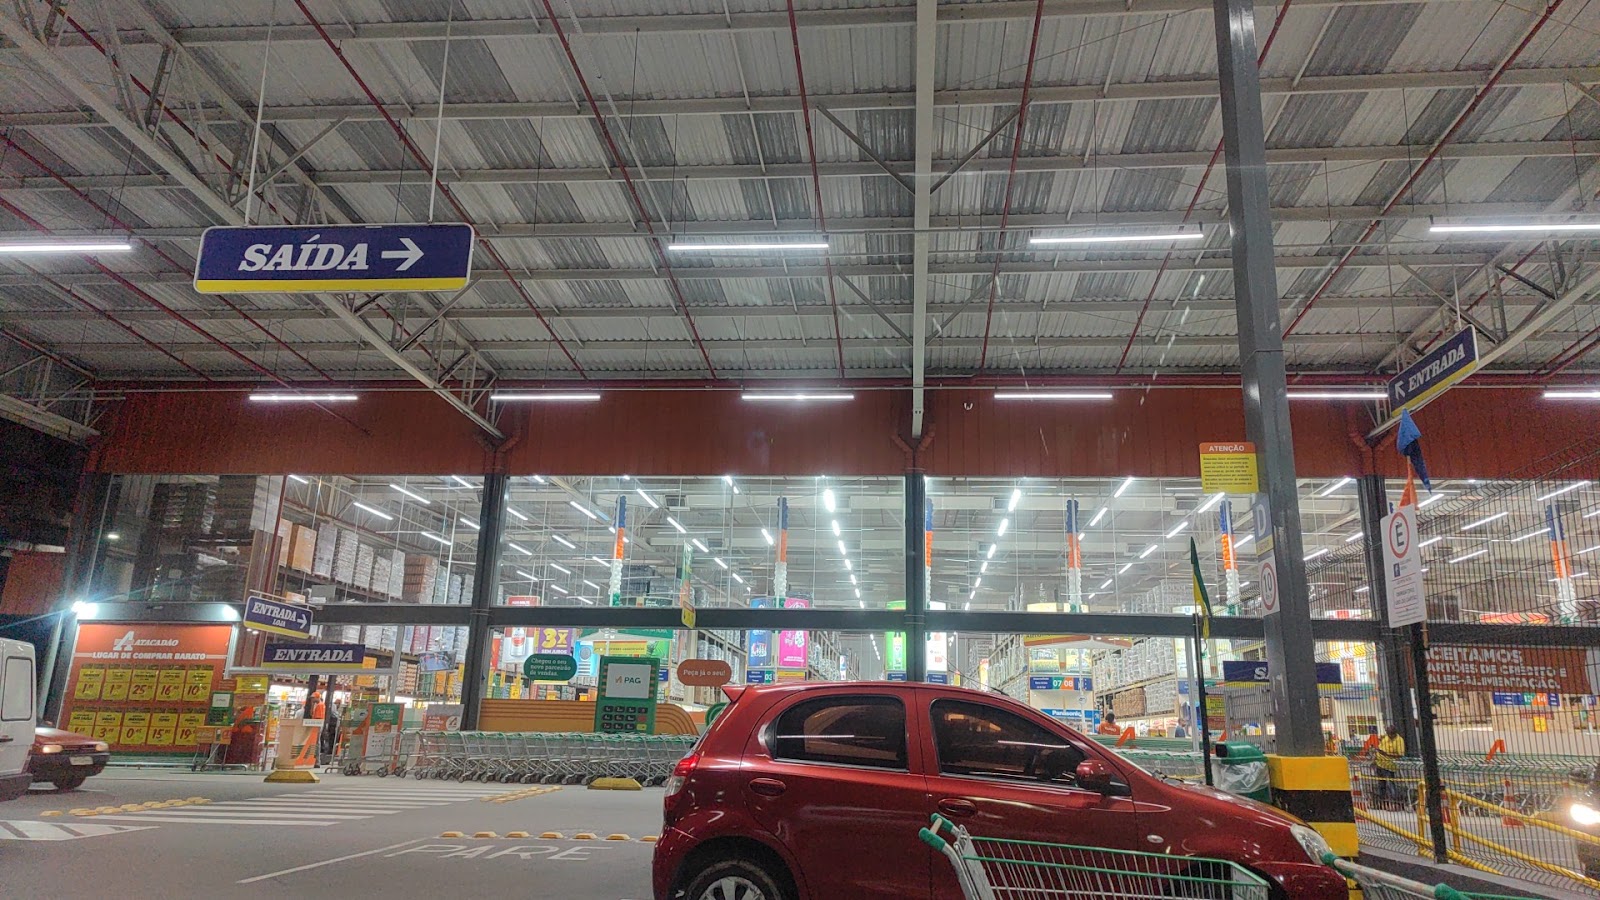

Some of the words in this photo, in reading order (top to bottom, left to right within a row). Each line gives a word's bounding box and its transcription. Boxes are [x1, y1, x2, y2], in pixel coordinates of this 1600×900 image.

[238, 234, 369, 271] SAÍDA
[1408, 343, 1466, 392] ENTRADA
[1209, 444, 1245, 453] ATENÇÃO
[1395, 521, 1405, 548] E
[1263, 572, 1273, 594] 10
[252, 601, 298, 622] ENTRADA
[272, 618, 286, 627] LOJA
[134, 639, 179, 647] ATACADÃO
[92, 652, 119, 660] LUGAR
[121, 652, 132, 660] DE
[132, 652, 174, 660] COMPRAR
[174, 652, 206, 660] BARATO
[273, 648, 354, 661] ENTRADA
[531, 657, 552, 665] Chegou
[683, 669, 698, 677] Peça
[700, 669, 706, 677] já
[1427, 661, 1477, 674] ARTÕES
[624, 676, 642, 684] PAG
[1052, 709, 1082, 717] Panasonic
[385, 844, 613, 861] PARE
